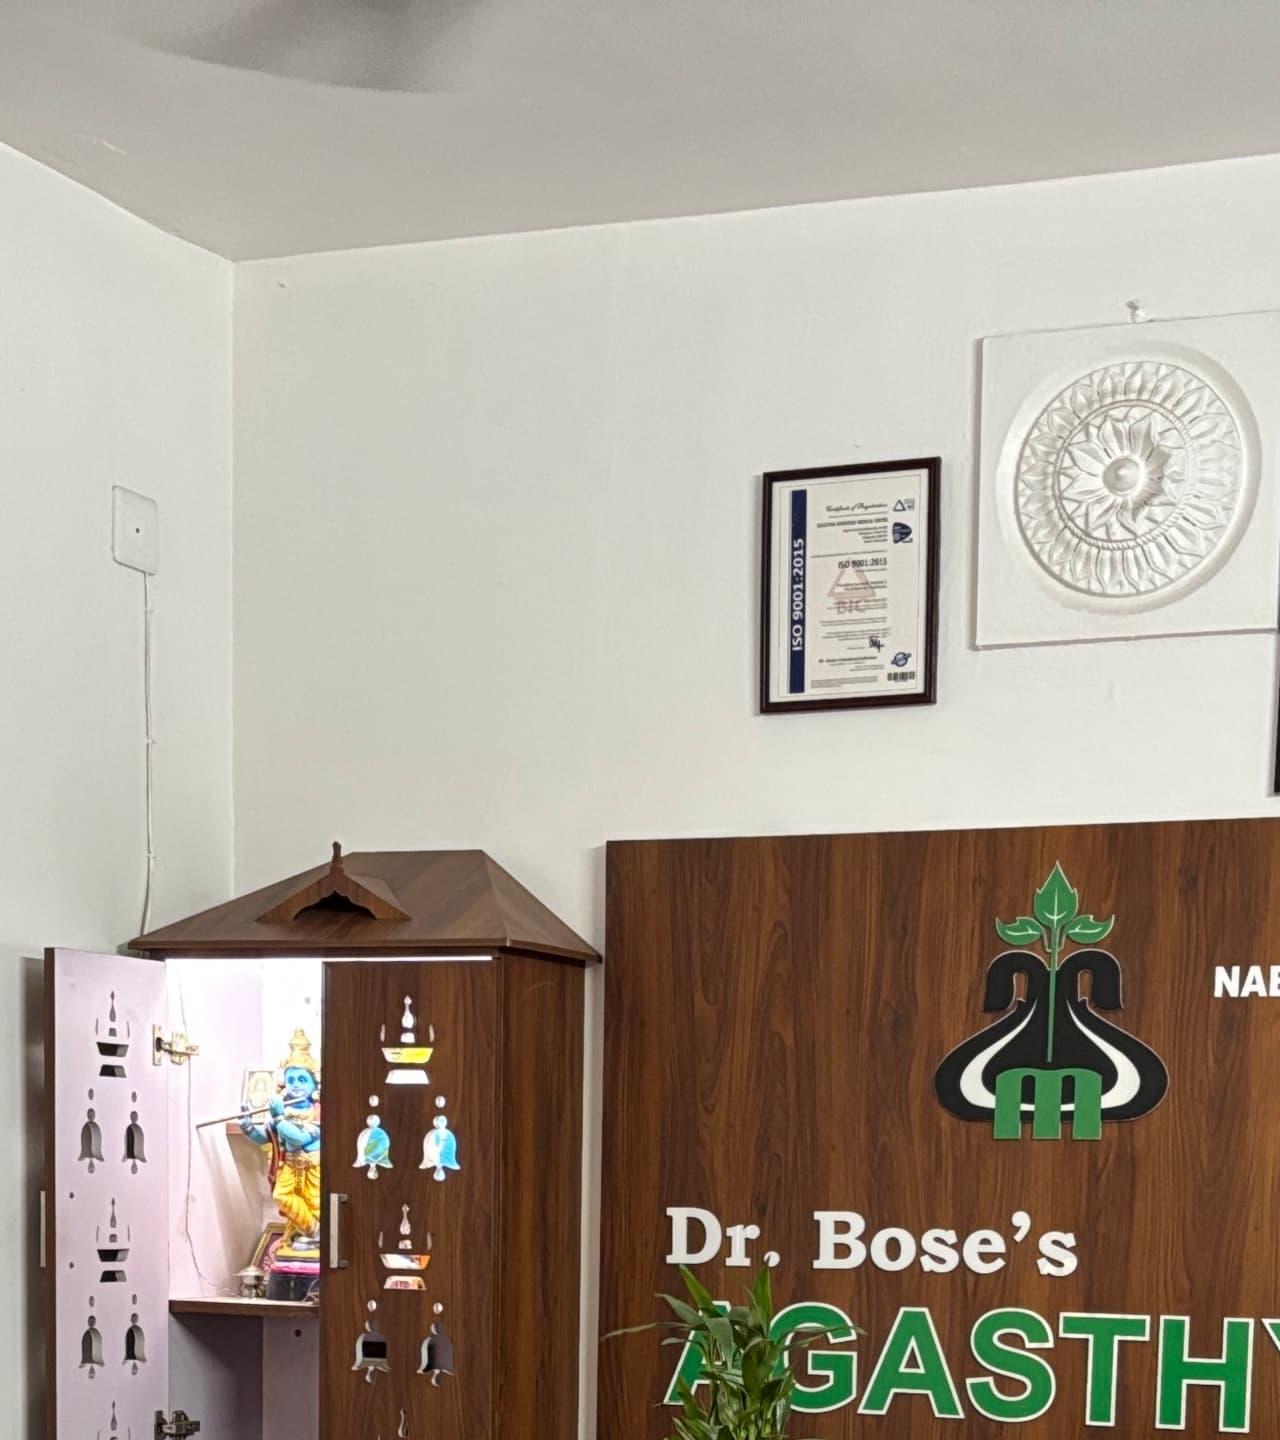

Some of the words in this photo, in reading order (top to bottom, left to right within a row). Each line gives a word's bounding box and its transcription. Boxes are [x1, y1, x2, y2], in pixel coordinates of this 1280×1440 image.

[793, 539, 805, 620] 9001:2015
[792, 626, 803, 651] ISO
[666, 1206, 781, 1268] Dr.
